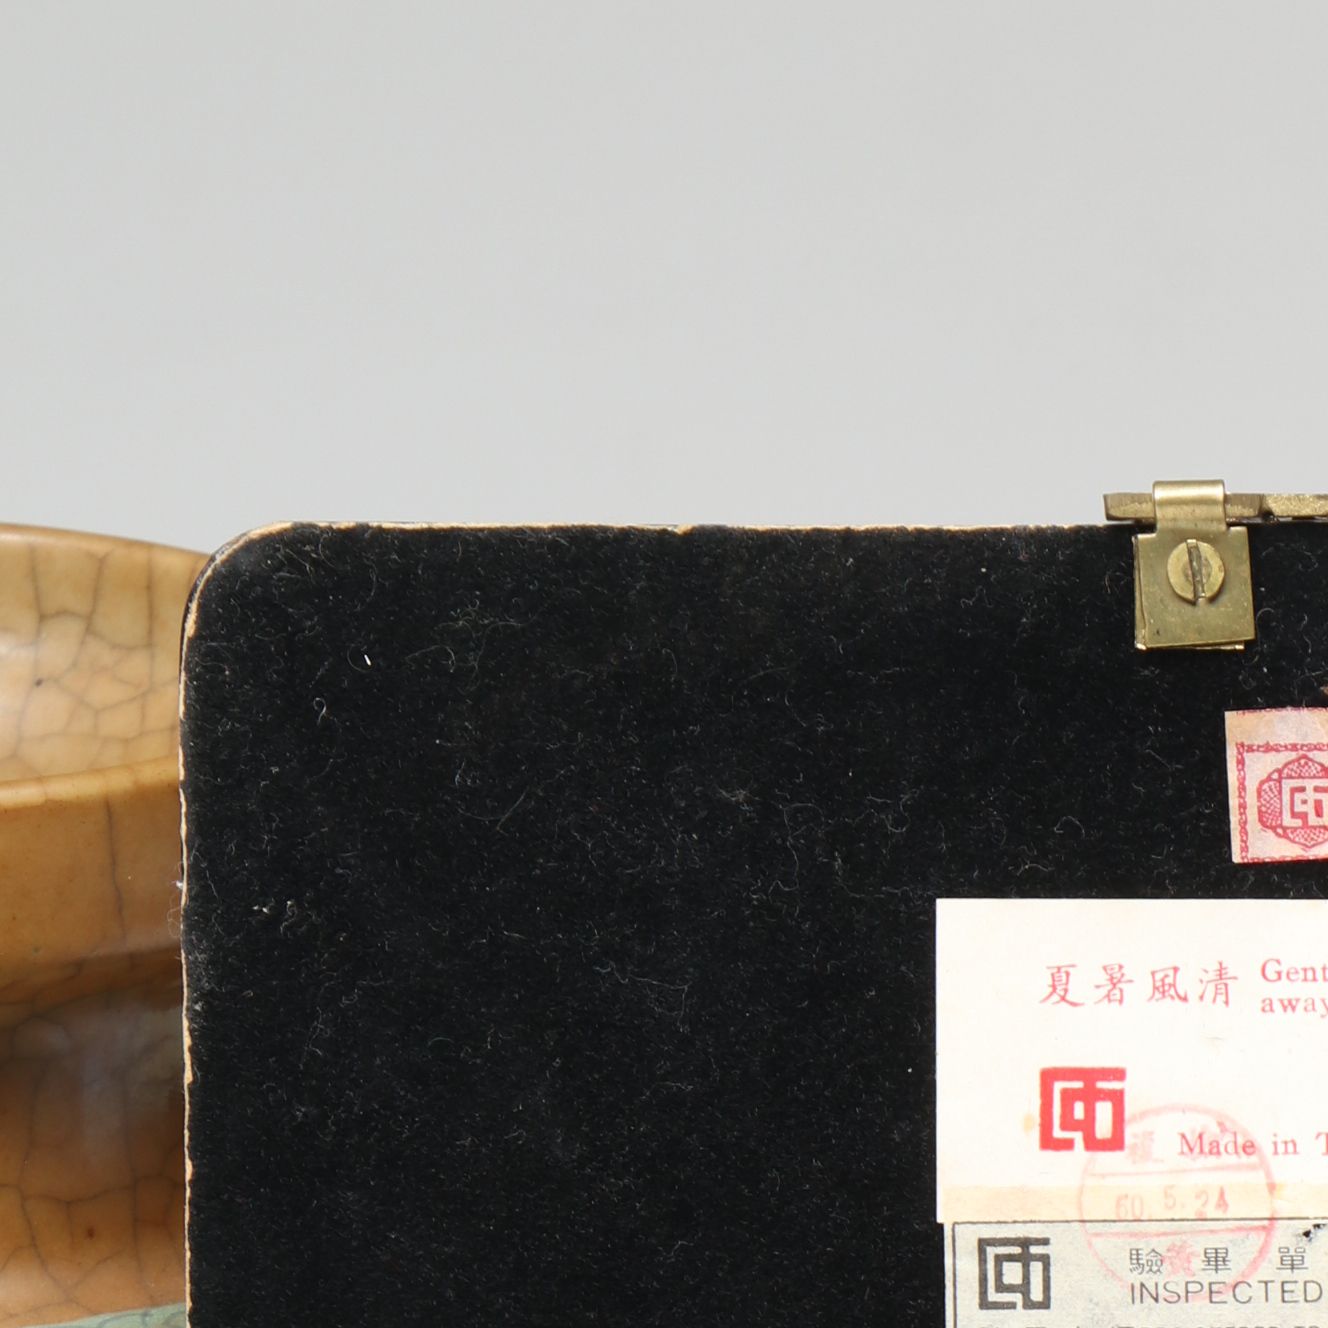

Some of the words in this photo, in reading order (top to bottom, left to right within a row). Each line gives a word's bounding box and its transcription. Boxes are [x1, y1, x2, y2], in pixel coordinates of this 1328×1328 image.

[1039, 960, 1239, 1008] 夏暑風清
[1178, 1131, 1257, 1157] Made
[1272, 1133, 1299, 1156] in
[1129, 1246, 1311, 1275] 驗畢單
[1130, 1280, 1323, 1305] INSPECTED
